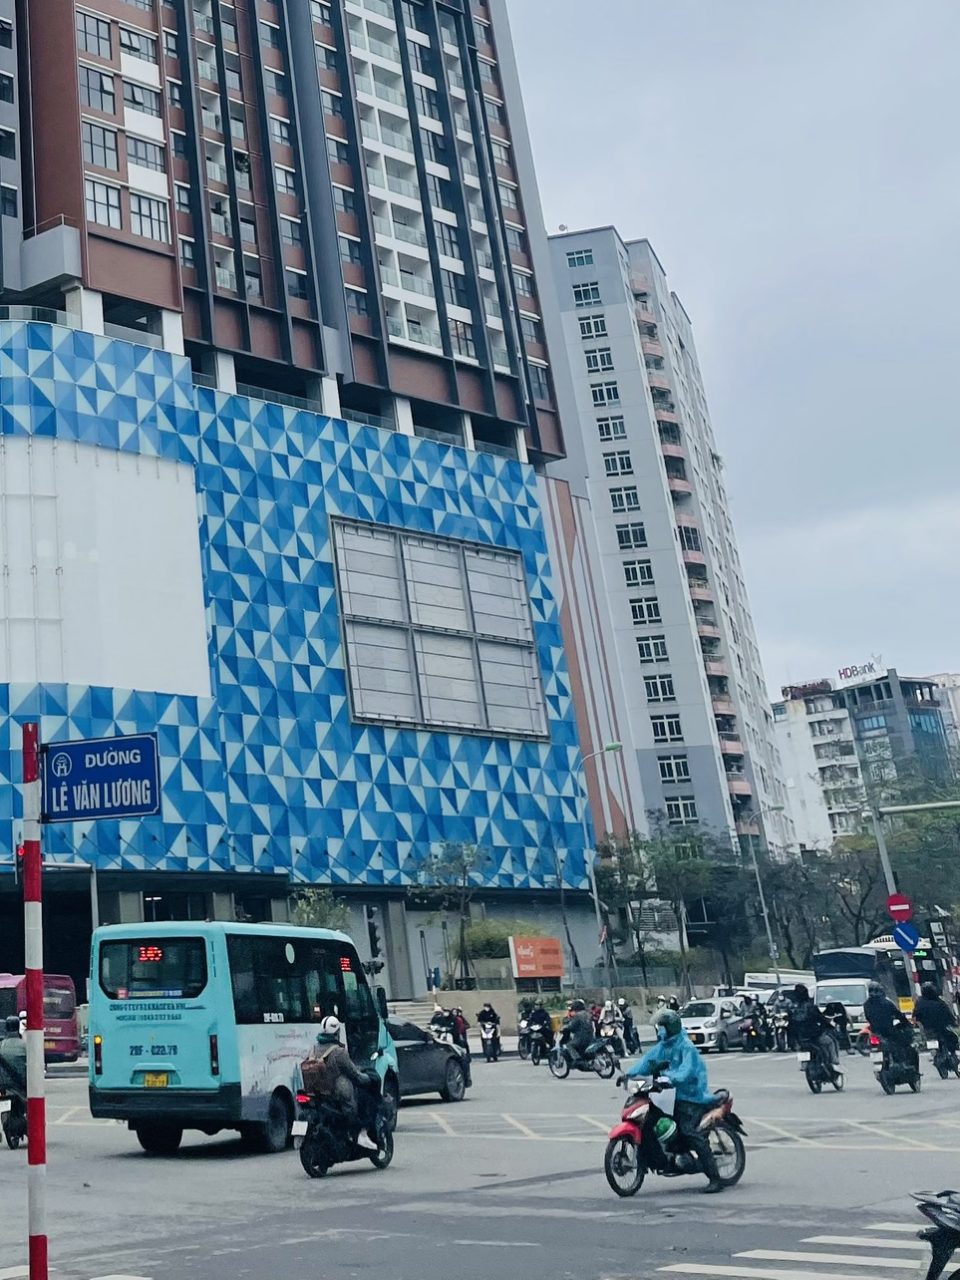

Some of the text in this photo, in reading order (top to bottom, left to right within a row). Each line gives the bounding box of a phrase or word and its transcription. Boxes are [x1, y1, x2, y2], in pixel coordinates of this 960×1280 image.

[838, 662, 876, 680] HDBank
[52, 778, 151, 812] LÊ VĂN LƯƠNG
